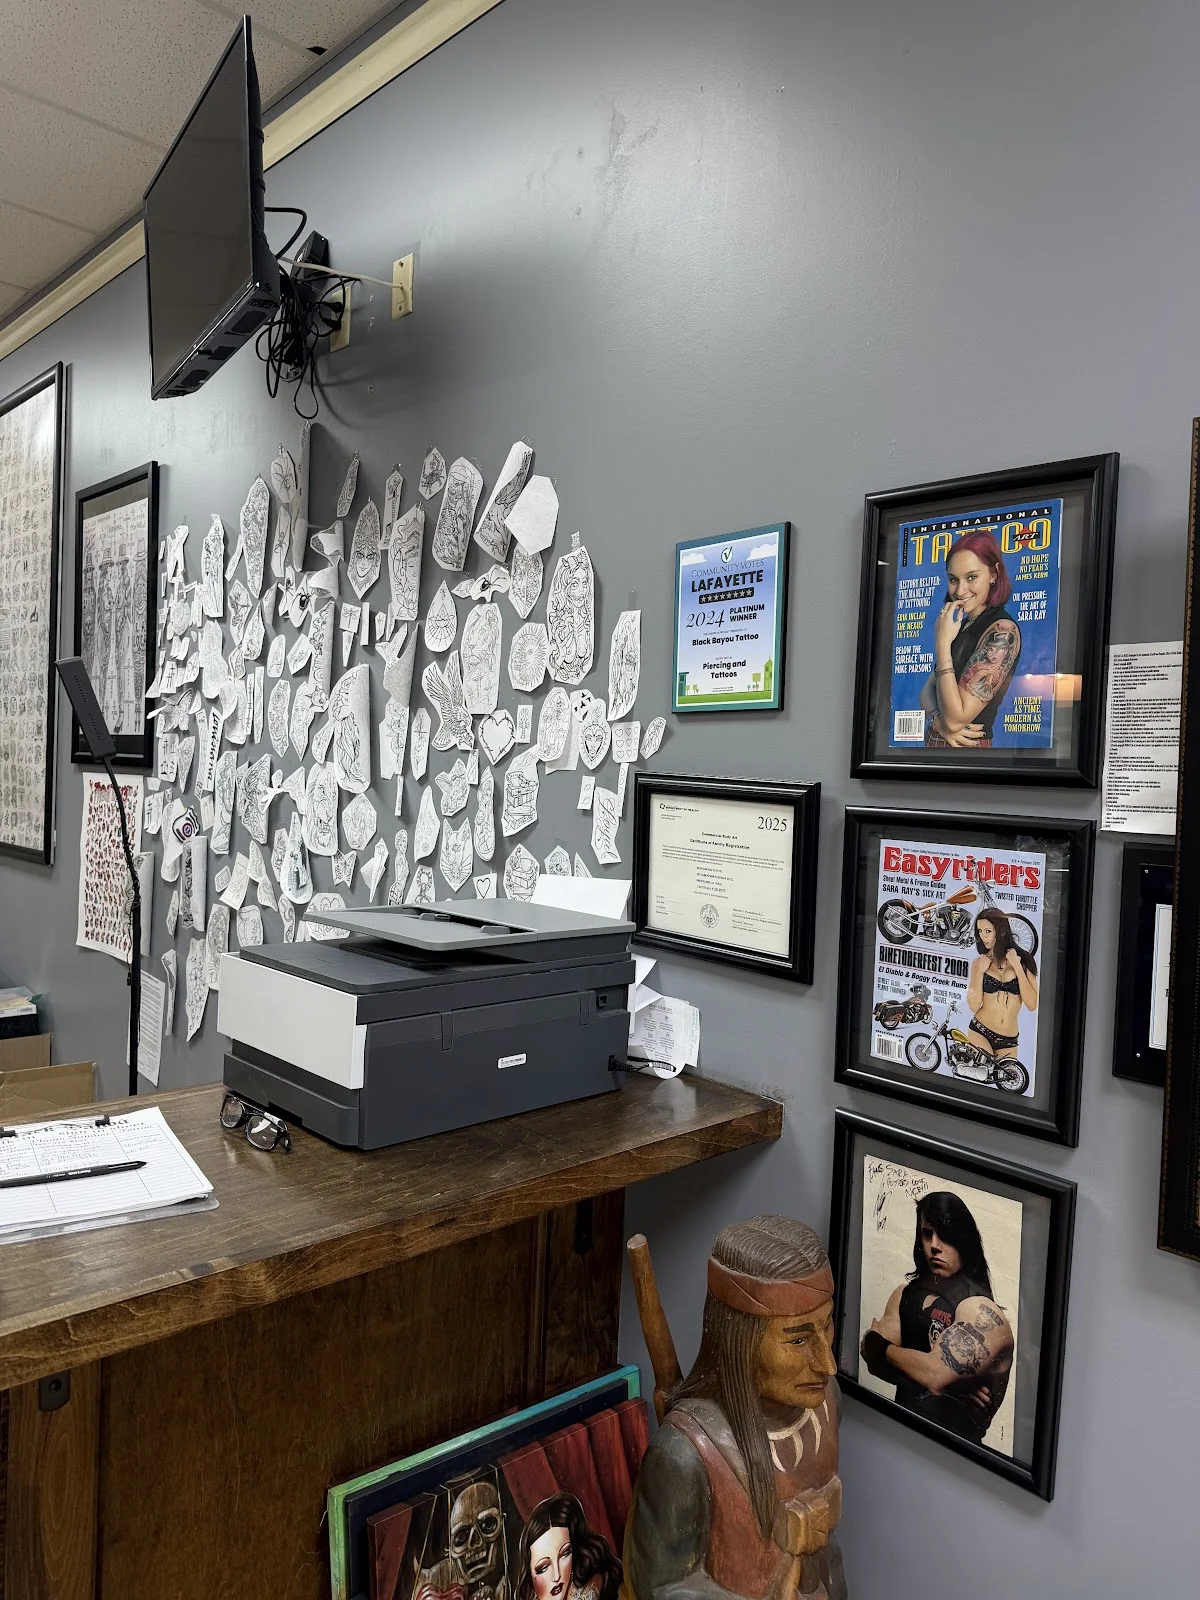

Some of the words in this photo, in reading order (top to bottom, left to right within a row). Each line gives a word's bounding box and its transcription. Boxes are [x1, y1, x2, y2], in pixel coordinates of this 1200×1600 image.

[913, 508, 1049, 533] INTERNATIONAL
[911, 518, 1051, 565] TAOO
[1013, 532, 1039, 541] ART
[1021, 556, 1030, 565] NO
[1031, 554, 1049, 564] HOPE
[691, 559, 764, 578] COMMUNITYVOTES
[1020, 565, 1027, 573] NO
[1028, 563, 1049, 572] FEAR'S
[692, 570, 763, 592] LAFAYETTE
[1015, 573, 1032, 581] JAMES
[898, 590, 908, 600] THE
[925, 586, 935, 597] ART
[1012, 593, 1020, 601] OIL
[729, 604, 765, 614] PLATINUM
[898, 601, 904, 609] OF
[1020, 602, 1028, 610] THE
[1030, 601, 1039, 610] ART
[1040, 600, 1046, 609] OF
[685, 609, 725, 628] 2024
[730, 613, 757, 622] WINNER
[1018, 611, 1032, 621] SARA
[1034, 610, 1046, 620] RAY
[907, 621, 923, 630] NEXUS
[903, 630, 920, 638] TEXAS
[692, 638, 711, 646] Black
[712, 636, 734, 645] Bayou
[735, 633, 759, 642] Tattoo
[896, 646, 911, 655] BELOW
[913, 645, 921, 653] THE
[896, 654, 918, 664] SURFACE
[919, 653, 933, 663] WITH
[703, 661, 731, 670] Piercing
[895, 664, 908, 674] MIKE
[908, 663, 931, 673] PARSONS
[711, 671, 737, 679] Tattoos
[1013, 696, 1042, 705] ANCIENT
[1014, 705, 1022, 713] AS
[1004, 714, 1031, 722] MODERN
[1033, 714, 1041, 722] AS
[1003, 724, 1040, 732] TOMORROW
[758, 816, 788, 831] 2025
[883, 846, 1041, 889] Easyriders
[914, 879, 930, 887] Frame
[882, 884, 899, 893] SARA
[902, 887, 920, 896] RAY'S
[922, 889, 934, 898] SICK
[936, 891, 946, 899] ART
[995, 892, 1014, 901] TWISTED
[1015, 894, 1038, 904] THROTTLE
[1016, 903, 1037, 912] CHOPPER
[879, 945, 942, 973] BIKETOBERFEST
[944, 957, 968, 978] 2008
[885, 967, 903, 977] Diablo
[911, 972, 931, 983] Boggy
[931, 977, 949, 986] Creek
[951, 981, 968, 989] Runs
[948, 991, 962, 1000] PUNCH
